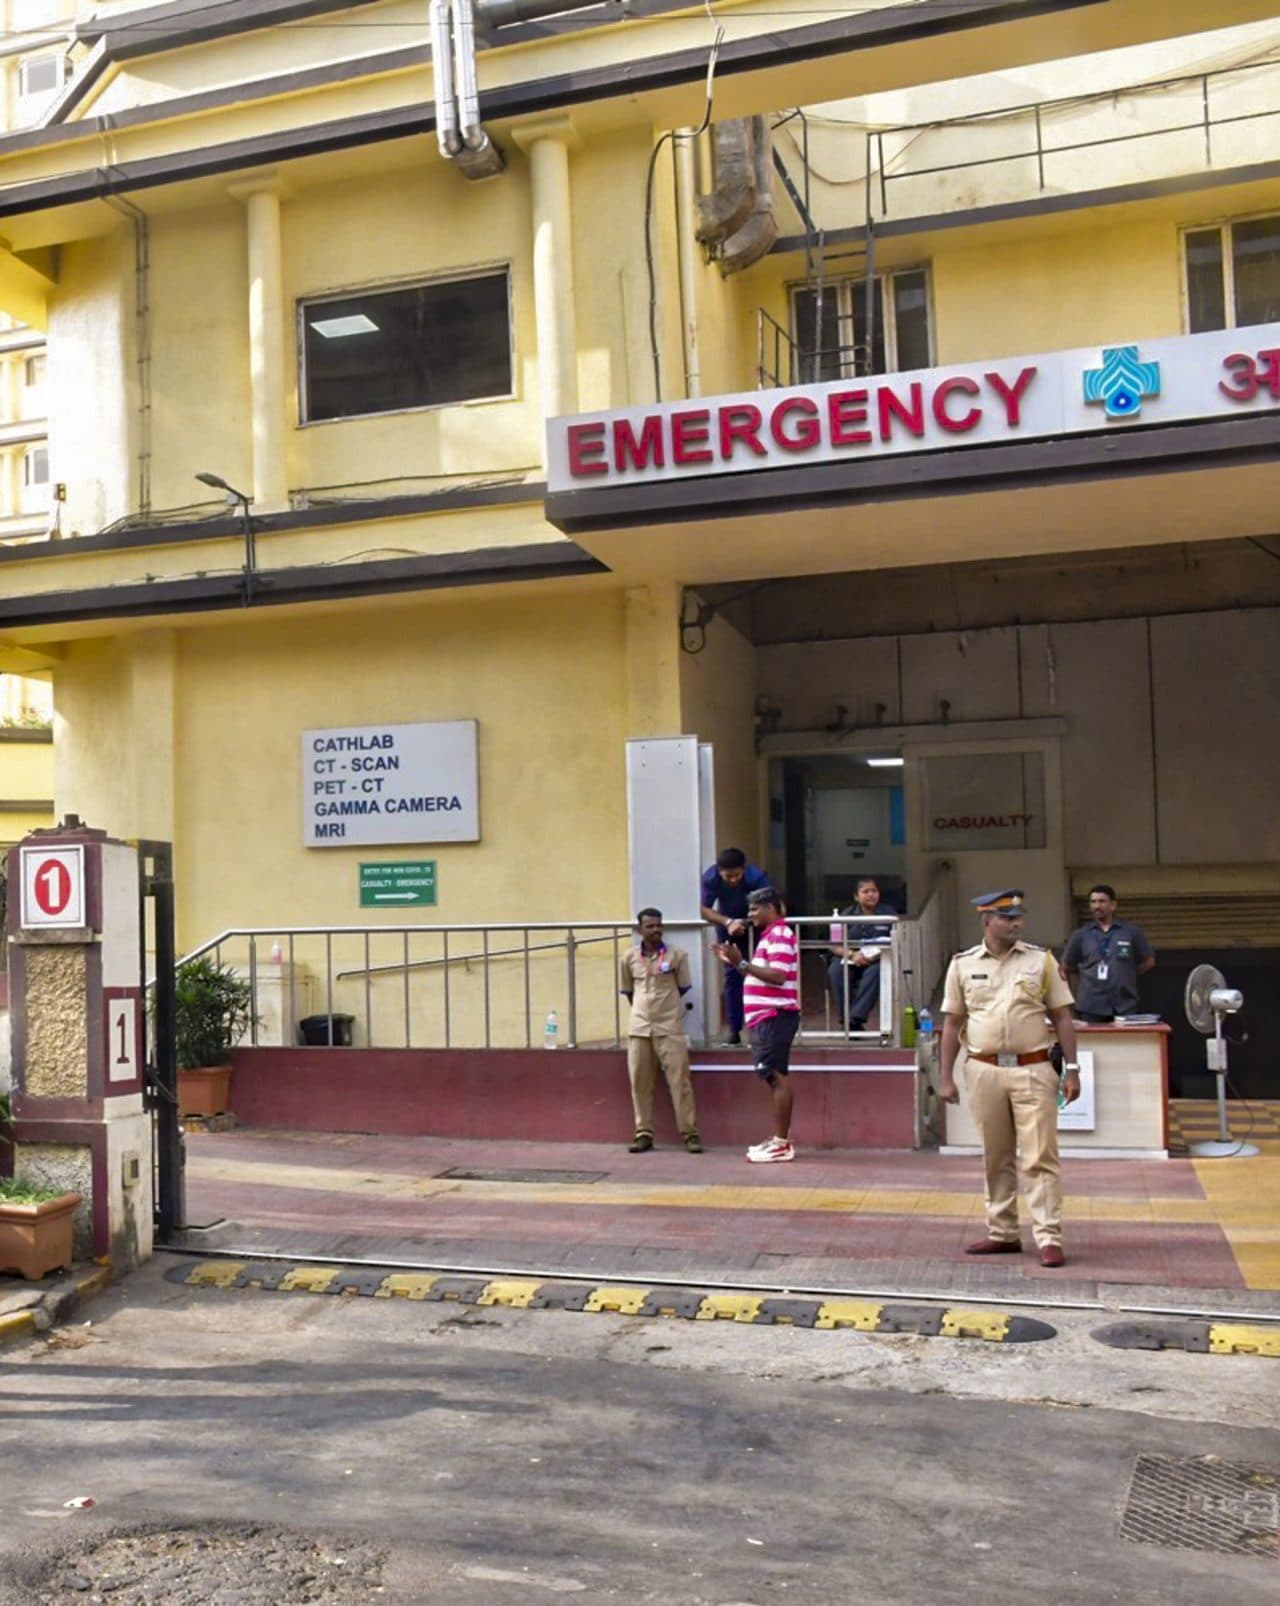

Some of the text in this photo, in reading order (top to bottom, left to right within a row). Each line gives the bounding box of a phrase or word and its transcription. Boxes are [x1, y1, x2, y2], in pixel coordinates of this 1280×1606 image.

[566, 366, 1037, 476] EMERGENCY
[313, 734, 394, 753] CATHLAB
[313, 759, 336, 775] CT
[351, 756, 400, 773] SCAN
[313, 780, 346, 796] PET
[361, 778, 385, 793] CT
[314, 796, 462, 817] GAMMA CAMERA
[314, 822, 346, 839] MRI
[933, 815, 1032, 830] CASUALTY
[41, 866, 61, 908] 1
[116, 1013, 130, 1064] 1
